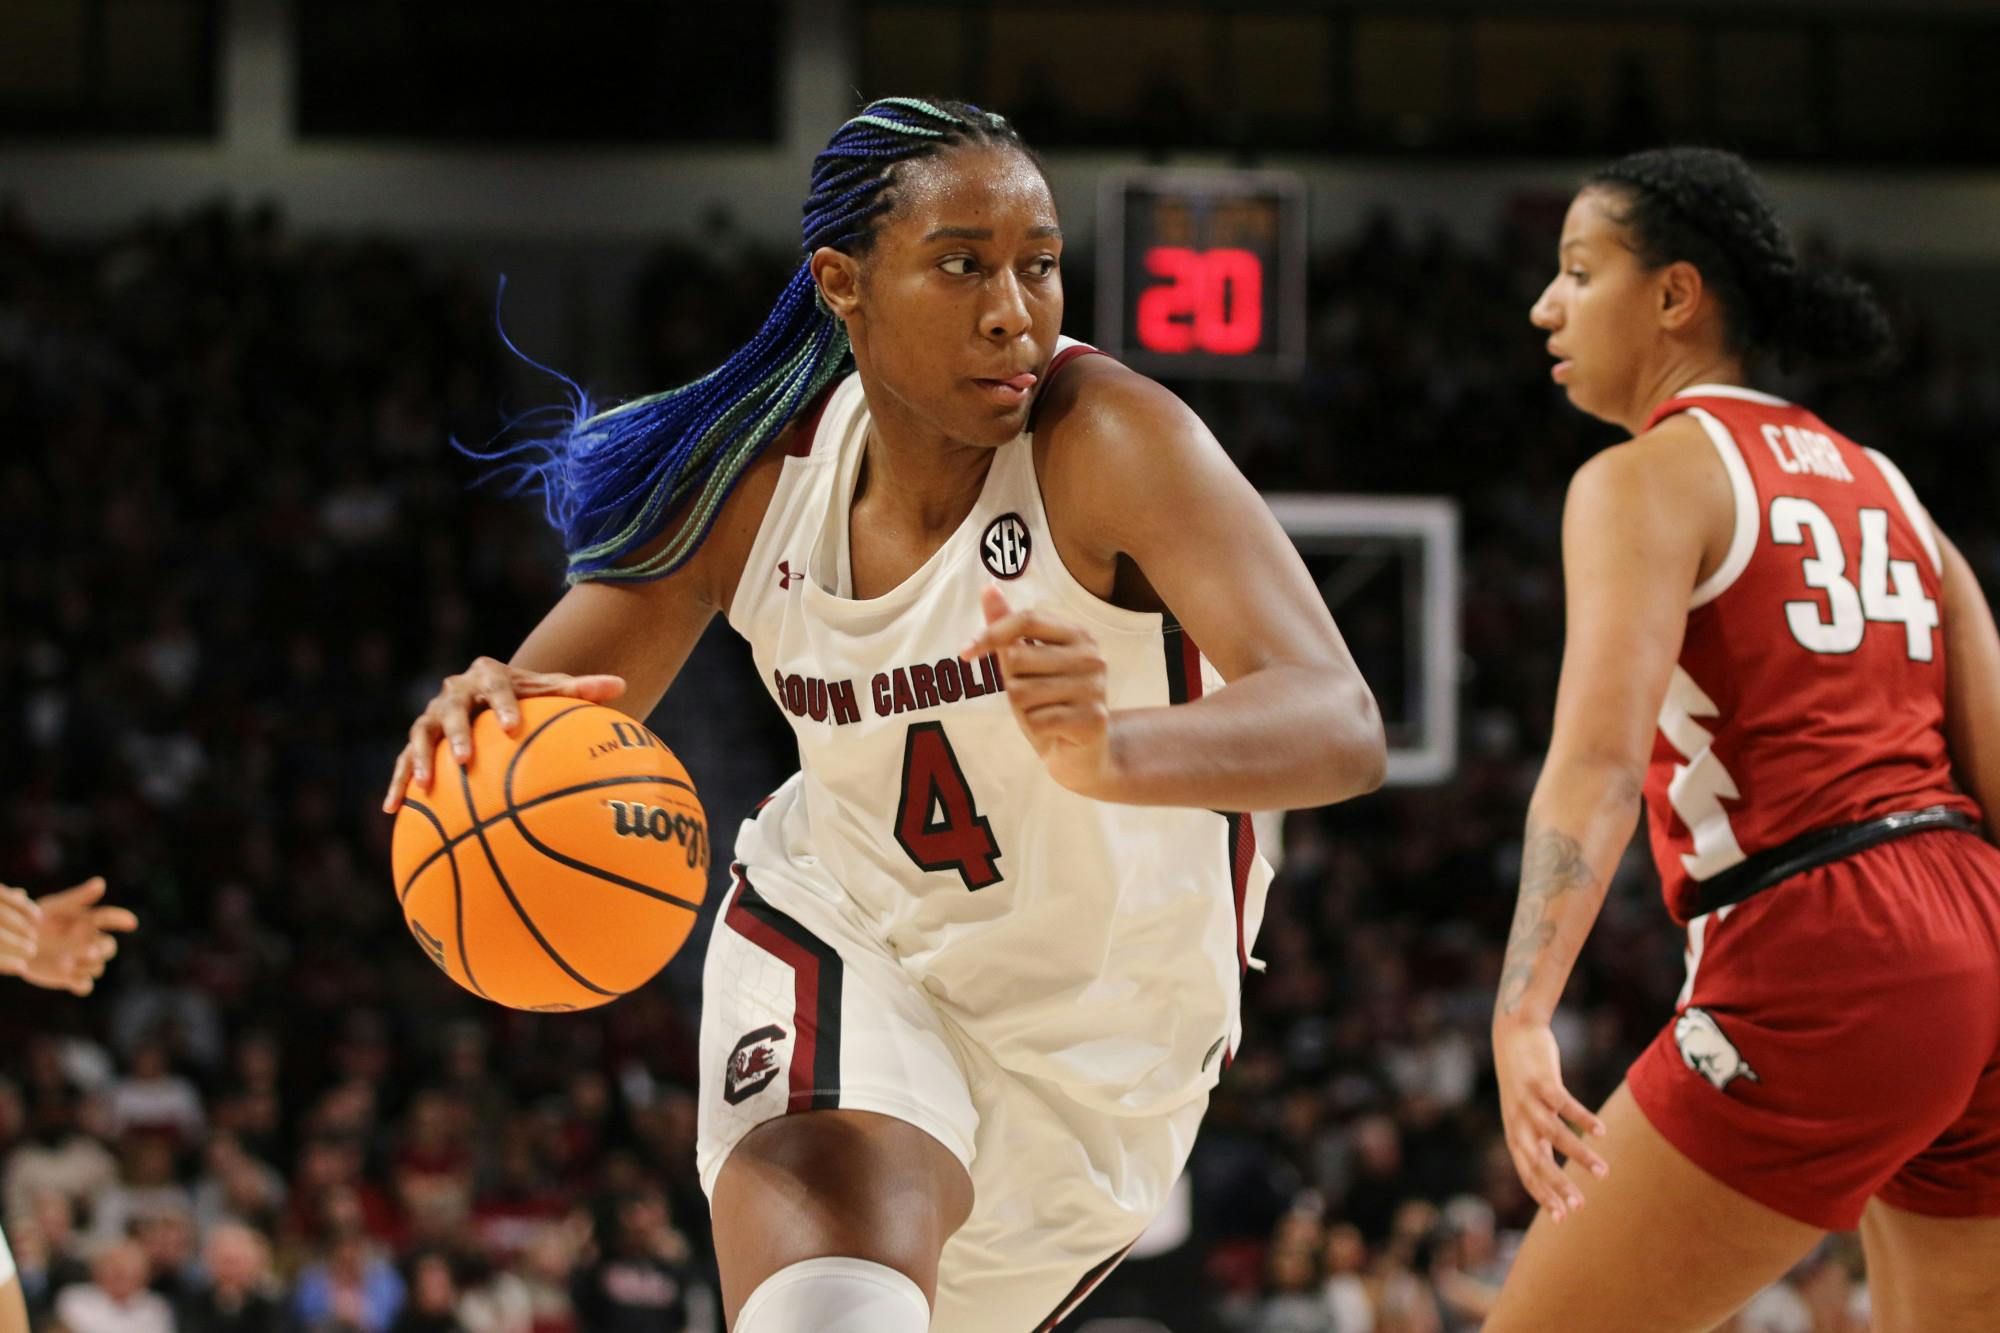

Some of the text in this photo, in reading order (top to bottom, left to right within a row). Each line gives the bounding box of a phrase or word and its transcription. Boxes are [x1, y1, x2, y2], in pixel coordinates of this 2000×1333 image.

[1138, 247, 1263, 355] 20
[1760, 424, 1855, 483] CARR
[984, 518, 1030, 577] SEC
[1769, 496, 1940, 664] 34
[774, 668, 862, 726] SOUH
[607, 799, 708, 870] ilson
[893, 720, 1005, 892] 4
